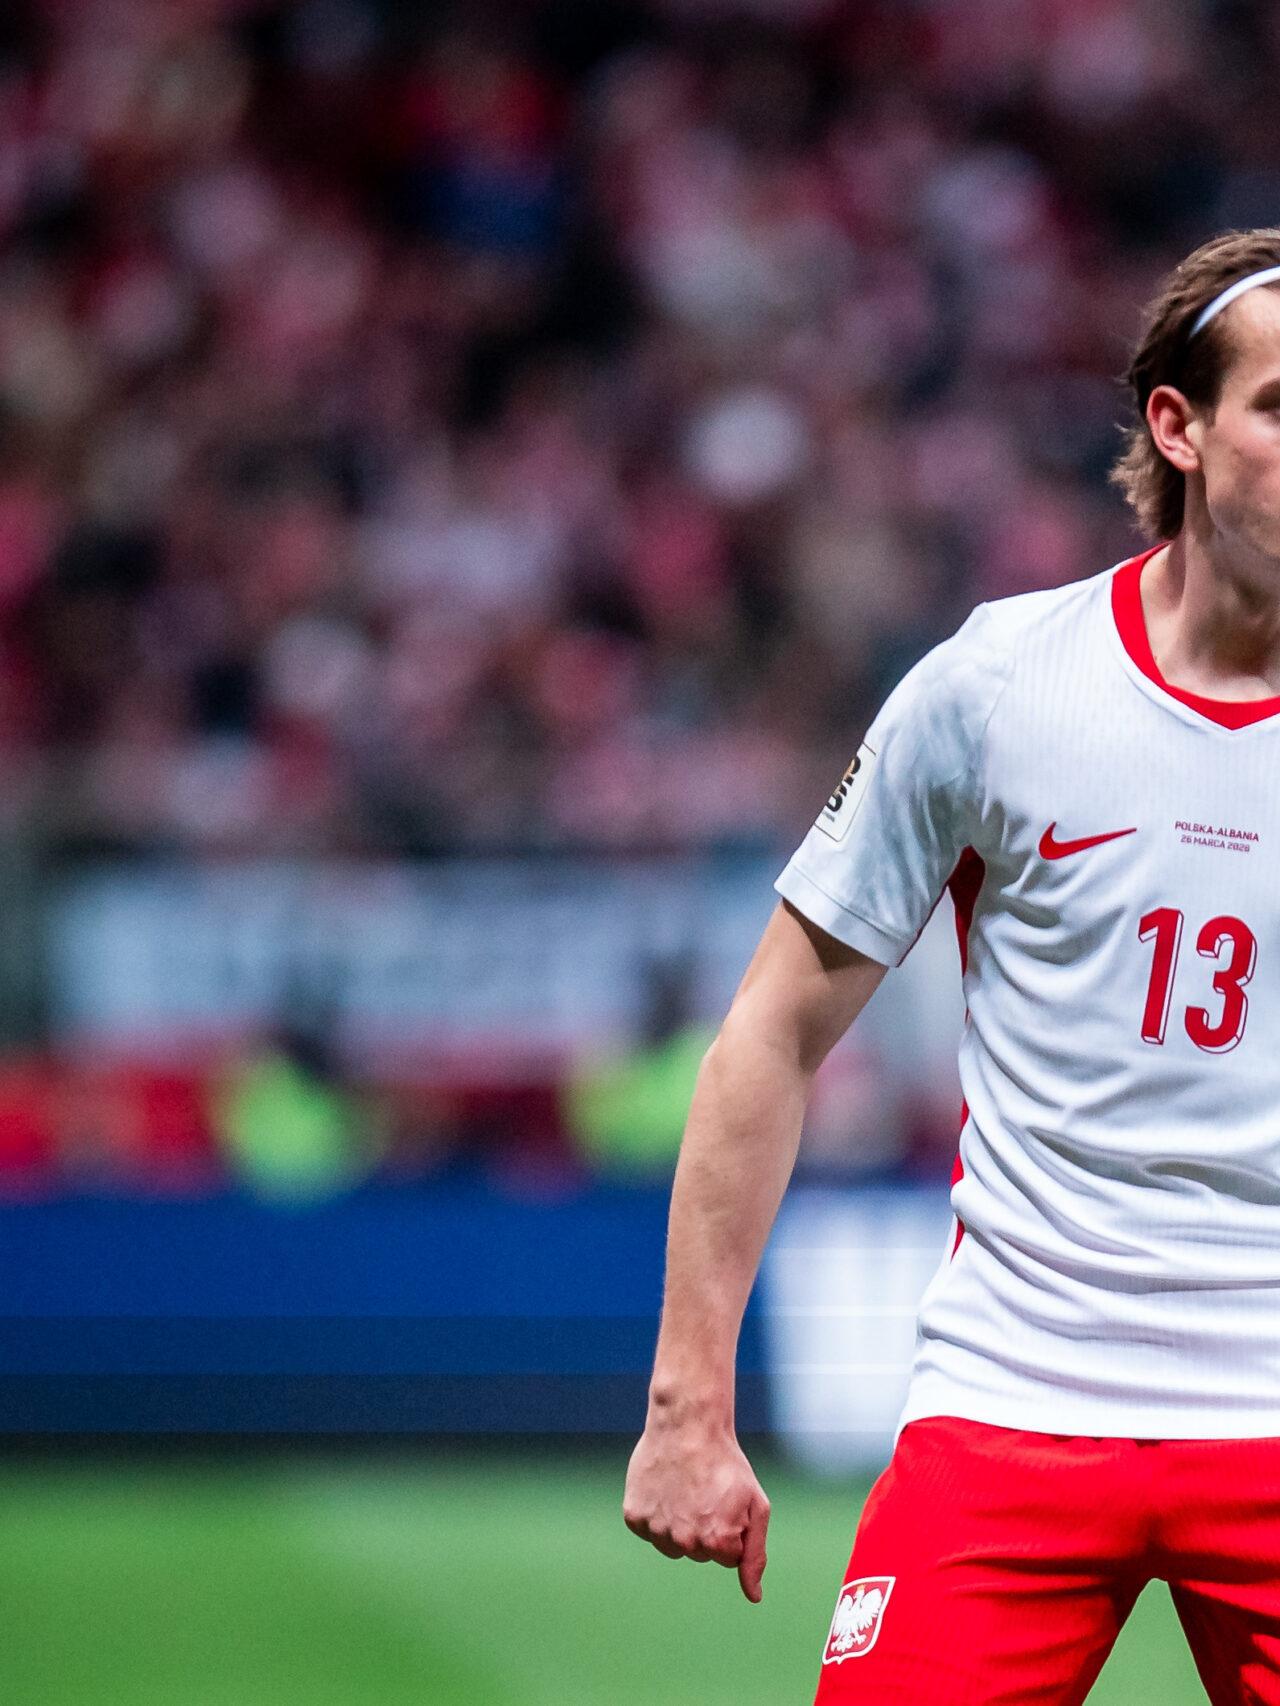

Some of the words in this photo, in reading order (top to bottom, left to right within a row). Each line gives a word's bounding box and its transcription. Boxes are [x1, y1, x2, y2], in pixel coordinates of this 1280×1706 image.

[1175, 821, 1259, 841] POLSKA-ALBANIA
[1193, 836, 1225, 848] MARCA
[1138, 906, 1258, 1054] 13
